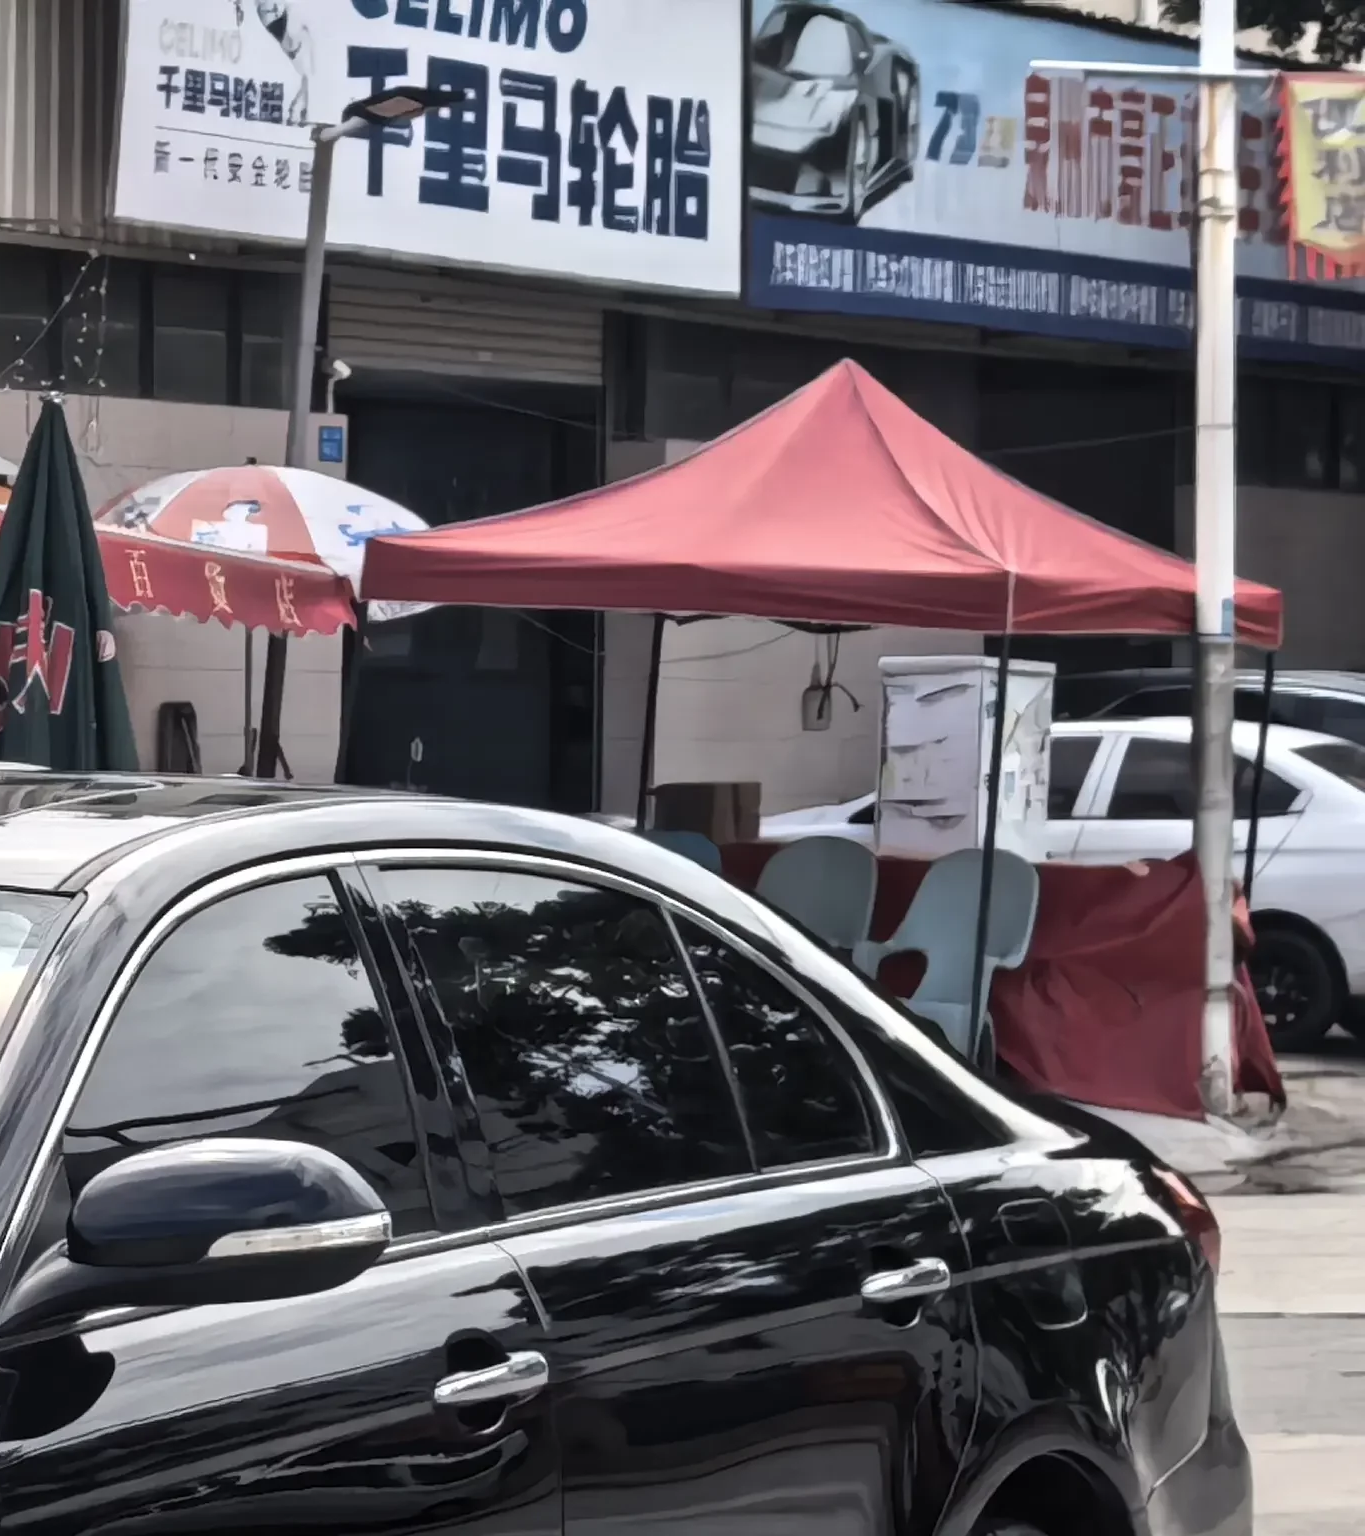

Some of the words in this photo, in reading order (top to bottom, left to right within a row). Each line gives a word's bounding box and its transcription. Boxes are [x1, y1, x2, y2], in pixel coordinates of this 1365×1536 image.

[156, 65, 285, 125] 千里马轮胎
[346, 45, 711, 241] 千里马轮胎
